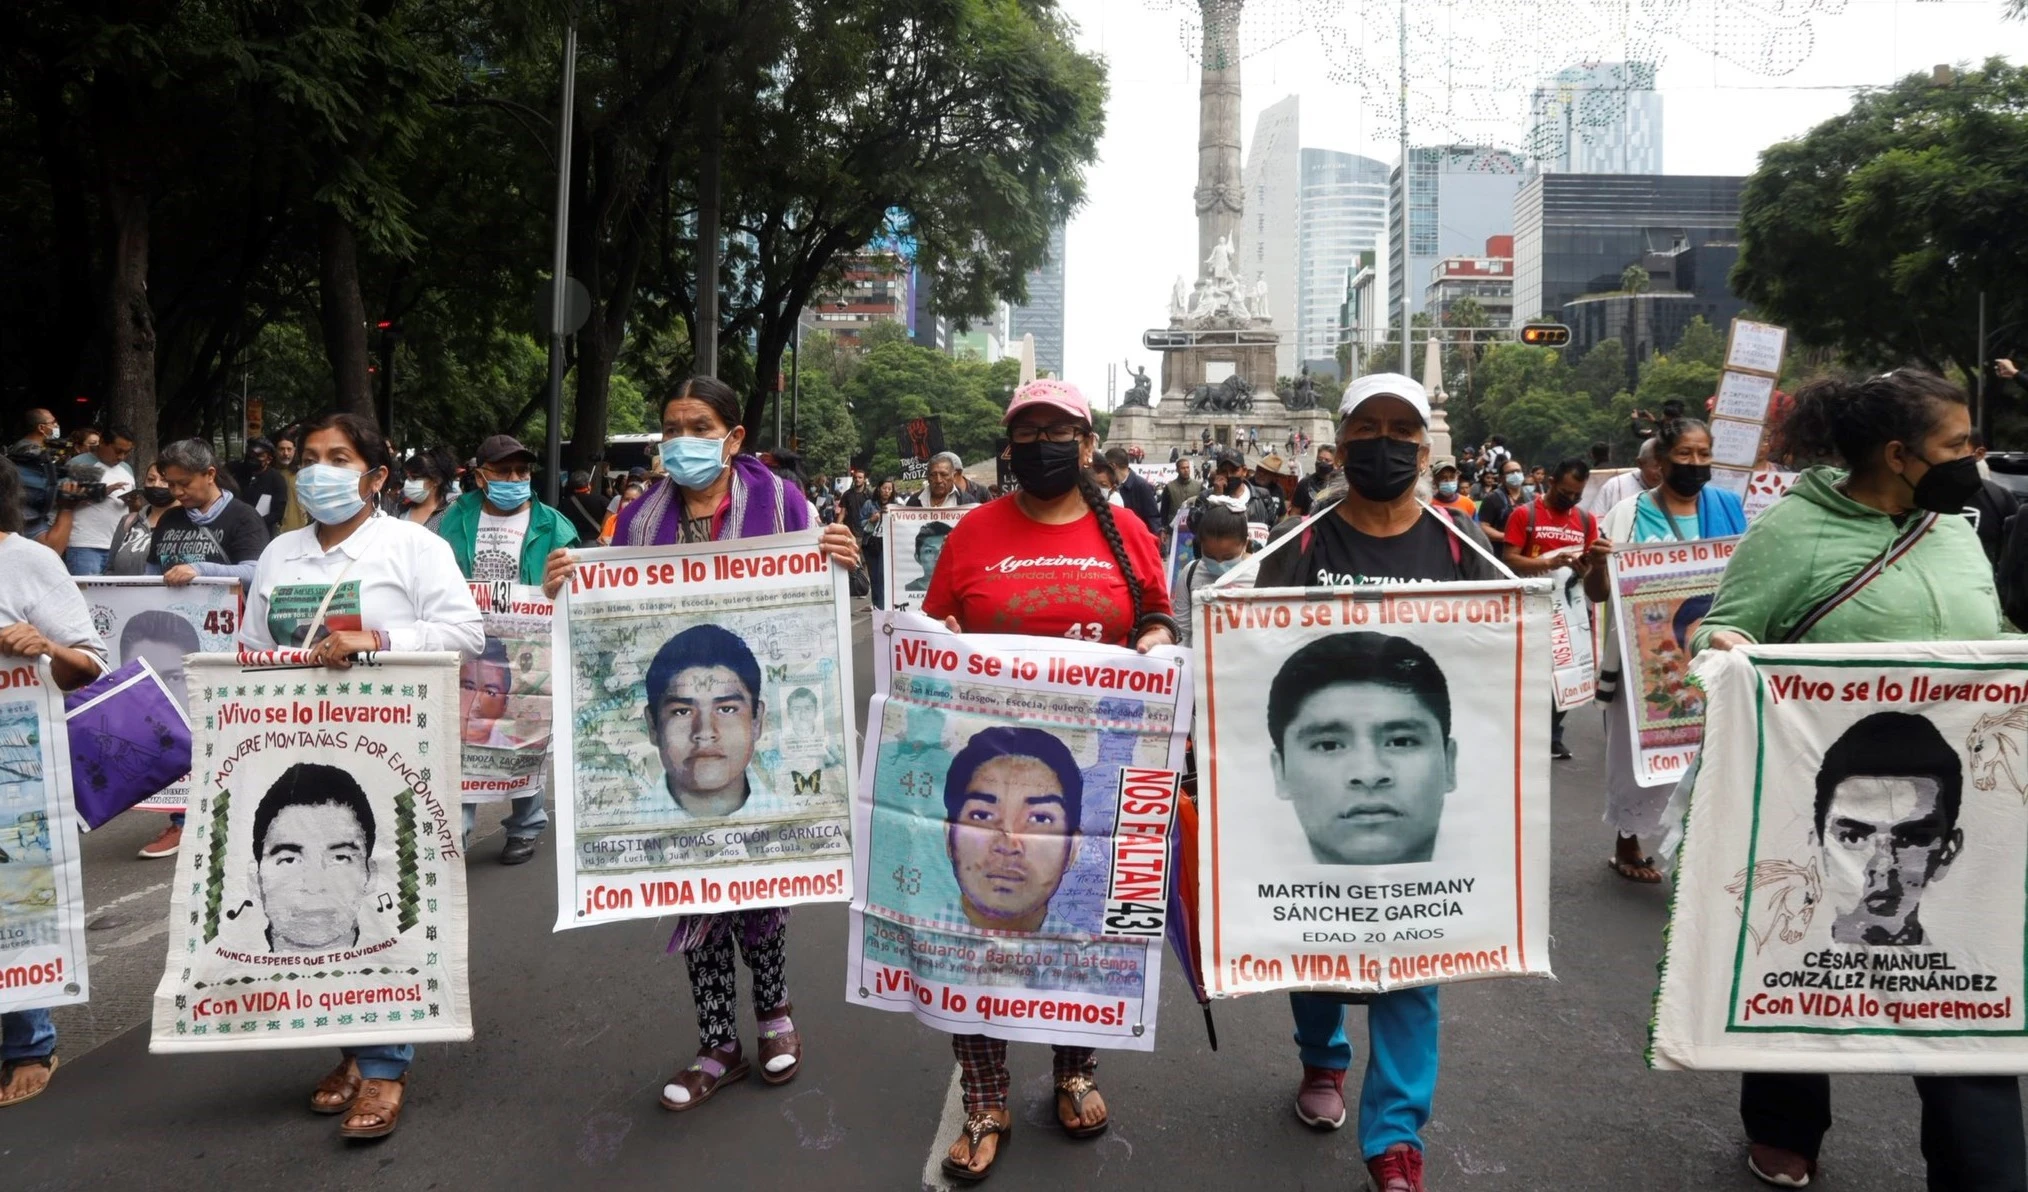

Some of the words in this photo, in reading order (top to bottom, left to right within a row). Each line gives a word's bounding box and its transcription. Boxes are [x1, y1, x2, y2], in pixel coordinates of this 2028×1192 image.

[930, 512, 939, 520] lo
[571, 562, 639, 594] ¡Vivo
[647, 563, 674, 585] se
[682, 558, 706, 583] lo
[714, 551, 828, 581] llevaron!
[985, 555, 1114, 573] Ayotzinapa
[1619, 550, 1663, 572] ¡Vivo
[1668, 549, 1687, 563] se
[1692, 545, 1708, 560] lo
[1063, 571, 1075, 580] ni
[491, 581, 511, 614] 43!
[681, 599, 718, 610] Escocia,
[722, 597, 751, 606] quiero
[755, 593, 778, 602] saber
[203, 609, 235, 635] 43
[1214, 600, 1292, 634] ¡Vivo
[1301, 602, 1332, 626] se
[1342, 598, 1368, 625] lo
[1379, 594, 1511, 625] llevaron!
[1064, 622, 1103, 642] 43
[895, 638, 959, 671] ¡Vivo
[967, 653, 1002, 677] se
[1011, 657, 1038, 680] lo
[1048, 659, 1175, 695] llevaron!
[959, 690, 1000, 706] Glasgow,
[1006, 698, 1046, 711] Escocia,
[1051, 702, 1085, 714] quiero
[1089, 706, 1112, 716] saber
[1767, 674, 1835, 704] ¡Vivo
[1840, 681, 1869, 702] se
[1876, 675, 1903, 702] lo
[218, 702, 261, 731] ¡Vivo
[265, 706, 288, 724] se
[292, 701, 310, 725] lo
[318, 700, 412, 725] llevaron!
[1648, 754, 1680, 774] ¡Con
[214, 735, 262, 789] MOVERE
[264, 729, 348, 750] MONTAÑAS
[354, 735, 389, 760] POR
[387, 752, 461, 863] ENCONTRARTE
[899, 770, 934, 798] 43
[1121, 769, 1174, 815] NOS
[583, 838, 662, 854] CHRISTIAN
[671, 831, 715, 849] TOMÁS
[724, 828, 770, 845] COLÓN
[779, 825, 842, 841] GARNICA
[585, 856, 605, 866] Hijo
[609, 855, 620, 864] de
[669, 851, 690, 860] Juan
[704, 849, 715, 858] 18
[719, 848, 740, 857] años
[755, 844, 805, 855] Tlacolula,
[1113, 821, 1167, 901] FALTAN
[585, 885, 633, 914] ¡Con
[640, 880, 695, 908] VIDA
[701, 877, 721, 904] lo
[728, 869, 844, 905] queremos!
[892, 865, 922, 896] 43
[1257, 880, 1341, 899] MARTÍN
[1346, 877, 1476, 900] GETSEMANY
[1104, 902, 1165, 937] 43!
[1272, 902, 1380, 922] SÁNCHEZ
[1384, 900, 1464, 921] GARCÍA
[1302, 930, 1357, 943] EDAD
[1363, 930, 1387, 943] 20
[1392, 927, 1445, 942] AÑOS
[215, 946, 252, 964] NUNCA
[254, 954, 301, 966] ESPERES
[303, 955, 325, 966] QUE
[328, 952, 343, 964] TE
[343, 937, 398, 961] OLVIDEMOS
[911, 939, 976, 962] Eduardo
[985, 950, 1053, 967] Bartolo
[1063, 952, 1138, 972] Tlatempa
[1230, 953, 1283, 986] ¡Con
[1291, 953, 1352, 982] VIDA
[1359, 952, 1380, 982] lo
[1388, 944, 1509, 981] queremos!
[1803, 949, 1868, 970] CÉSAR
[1872, 952, 1956, 971] MANUEL
[1762, 970, 1865, 990] GONZÁLEZ
[1869, 972, 1998, 992] HERNÁNDEZ
[191, 998, 239, 1021] ¡Con
[241, 991, 292, 1013] VIDA
[296, 988, 313, 1010] lo
[319, 984, 422, 1012] queremos!
[875, 967, 933, 1006] ¡Vivo
[941, 986, 967, 1013] lo
[976, 995, 1126, 1026] queremos!
[1743, 992, 1794, 1021] ¡Con
[1799, 992, 1855, 1018] VIDA
[1858, 993, 1879, 1017] lo
[1883, 996, 2012, 1024] queremos!
